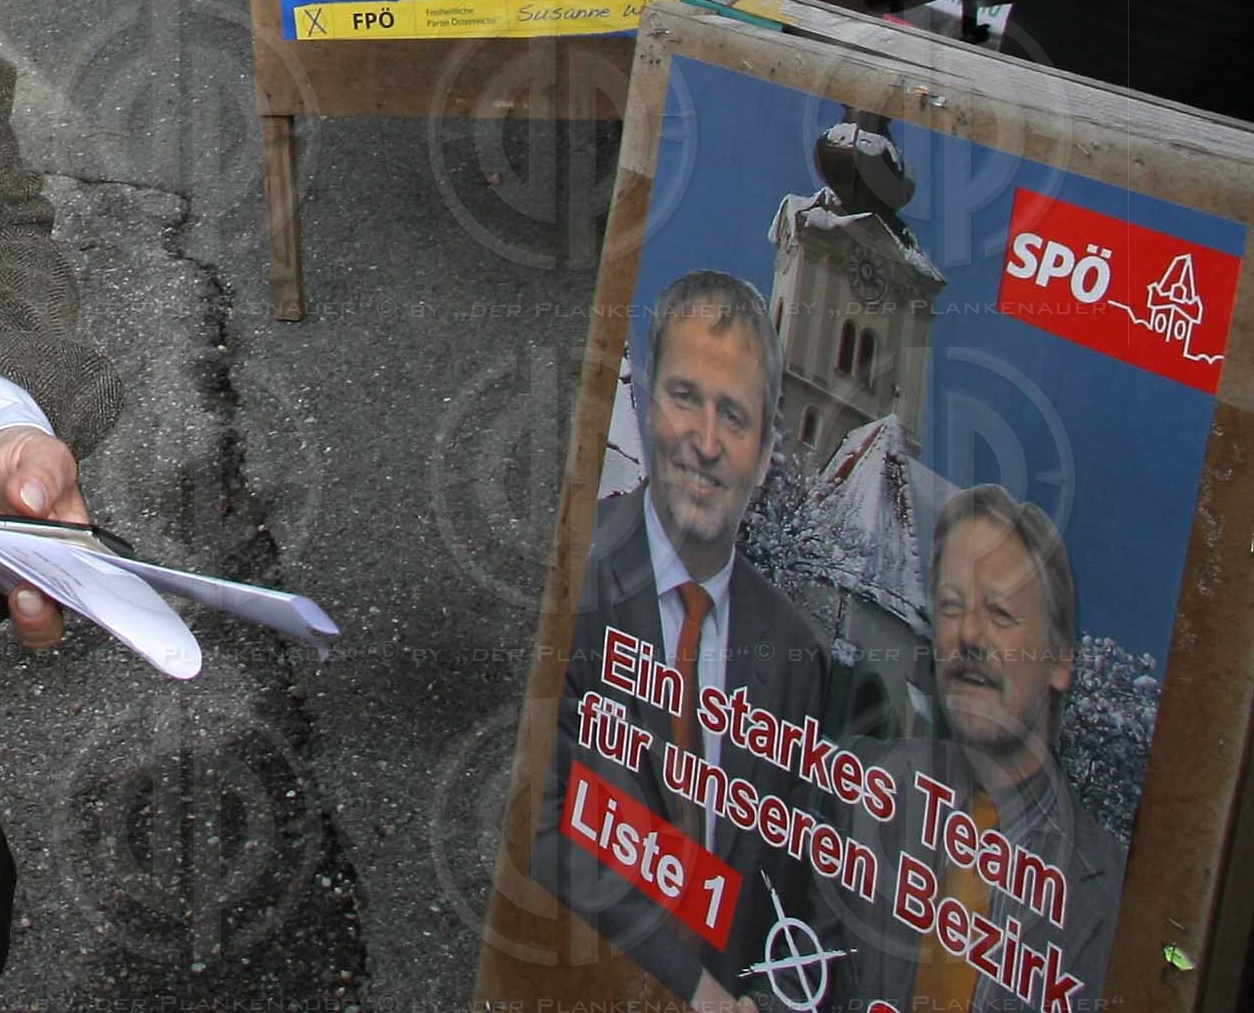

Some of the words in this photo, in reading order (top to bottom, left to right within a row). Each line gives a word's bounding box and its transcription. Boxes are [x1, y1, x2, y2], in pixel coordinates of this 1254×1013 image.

[352, 8, 395, 30] FPÖ
[518, 4, 611, 22] Susanne
[1005, 232, 1113, 304] SPÖ
[600, 625, 685, 717] Ein
[696, 683, 898, 823] starkes
[913, 769, 1068, 930] Team
[569, 778, 686, 898] Liste
[701, 874, 729, 930] 1
[577, 690, 652, 773] für
[663, 741, 879, 903] unseren
[892, 850, 1085, 1013] Bezirk
